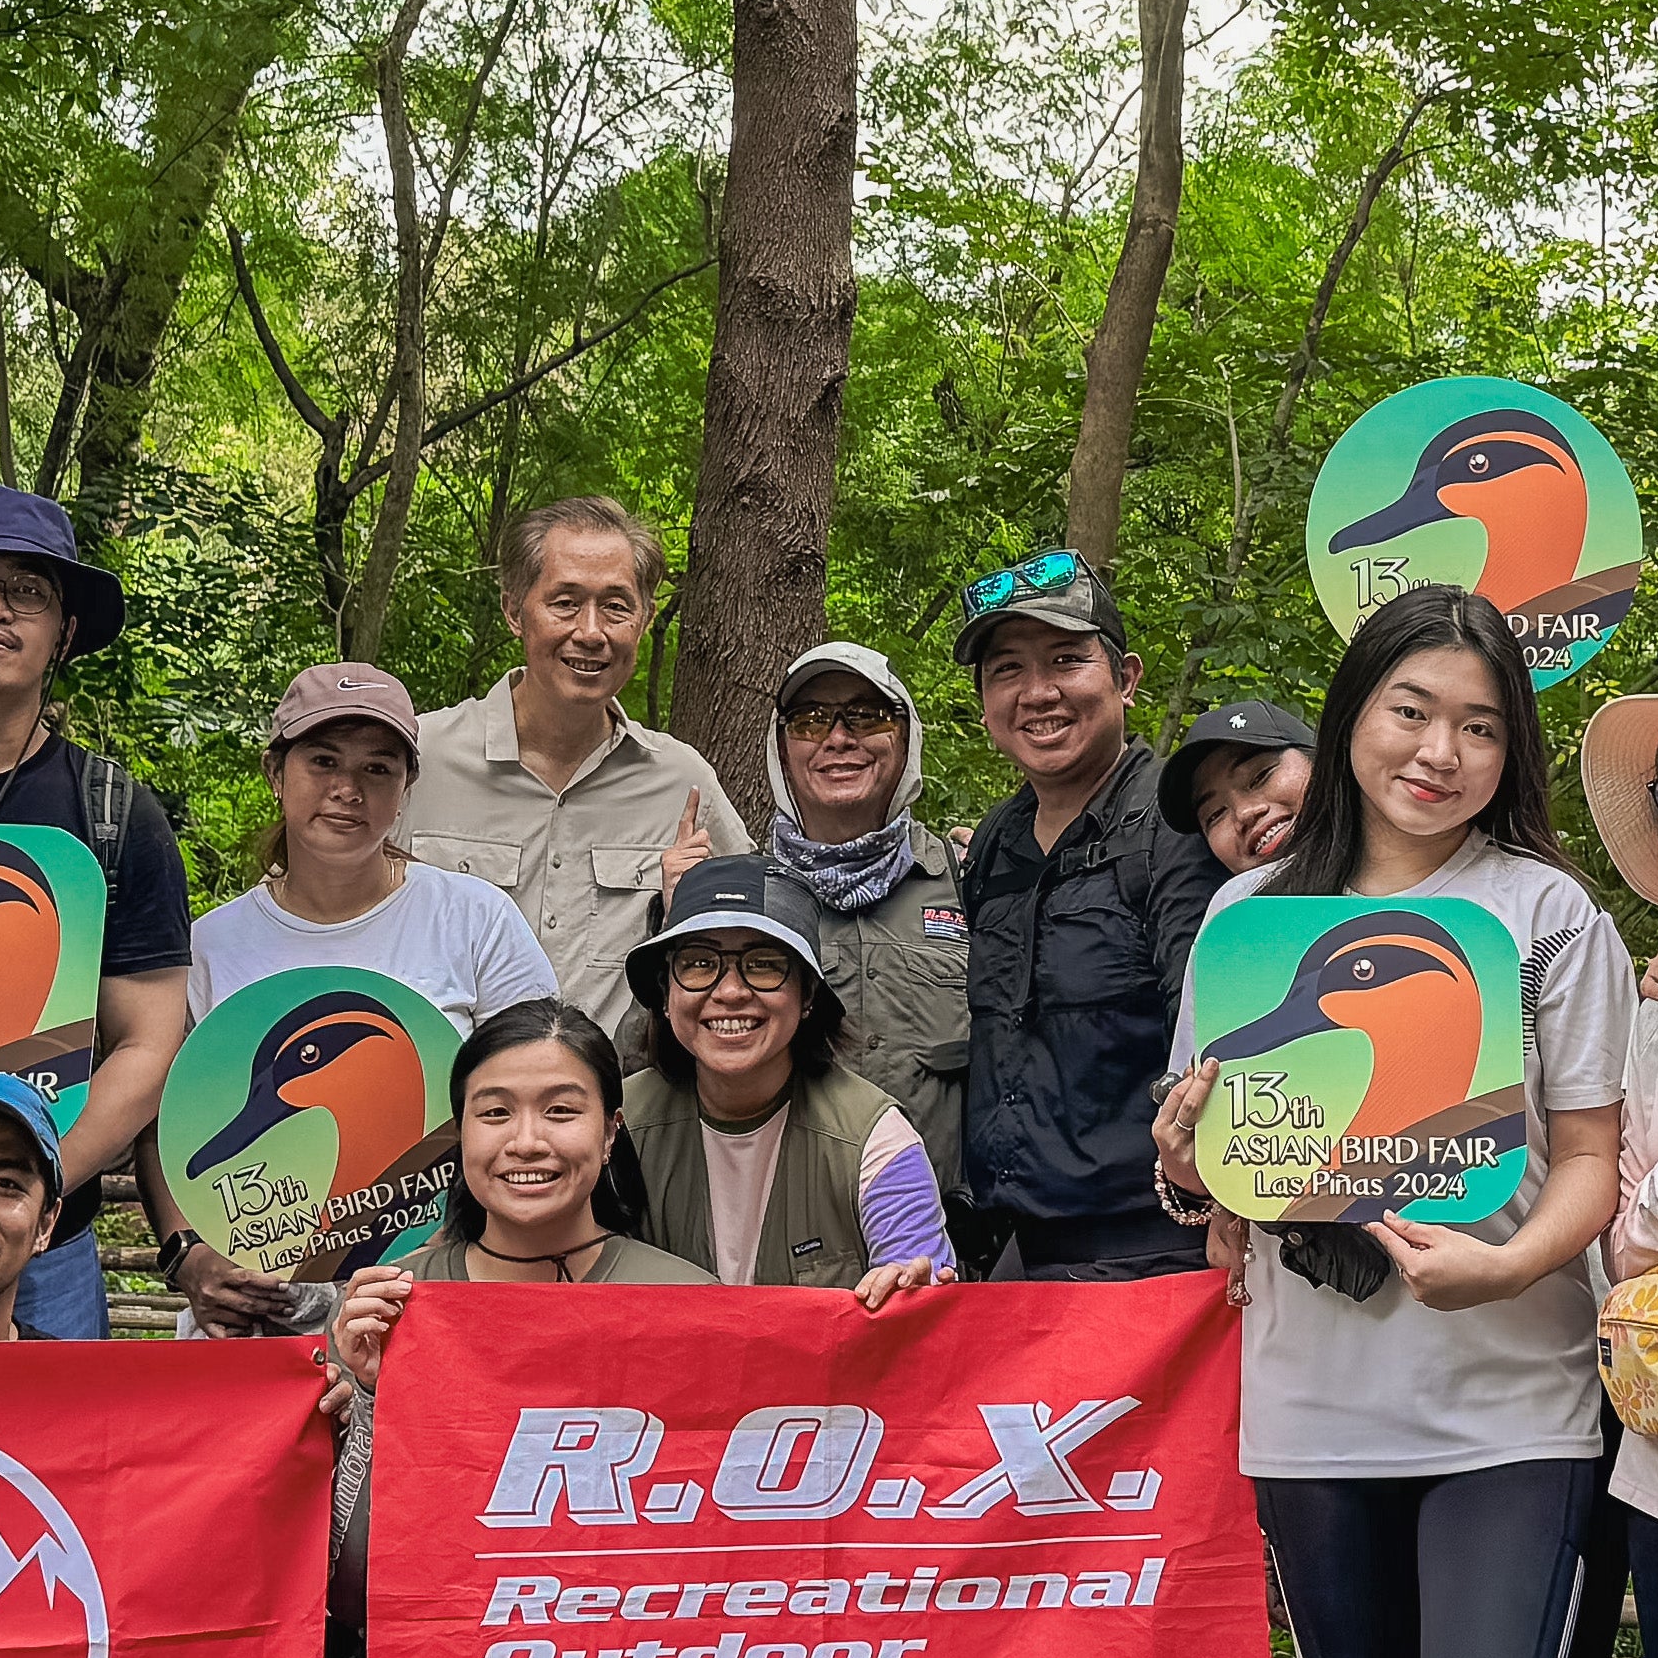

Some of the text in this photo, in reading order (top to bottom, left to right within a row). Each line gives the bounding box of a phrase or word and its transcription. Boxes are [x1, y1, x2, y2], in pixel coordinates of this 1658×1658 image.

[1350, 557, 1430, 608] 13
[1537, 612, 1601, 641] FAIR
[1522, 645, 1572, 670] 024
[1223, 1071, 1324, 1129] 13th
[1222, 1134, 1499, 1168] ASIAN BIRD FAIR
[212, 1161, 308, 1224] 13th
[1254, 1170, 1467, 1199] Las Piñas 2024
[228, 1203, 322, 1256] ASIAN
[326, 1183, 394, 1223] BIRD
[259, 1202, 442, 1274] Las Piñas 2024
[475, 1395, 1163, 1528] R.O.X.
[479, 1557, 1167, 1627] Recreational
